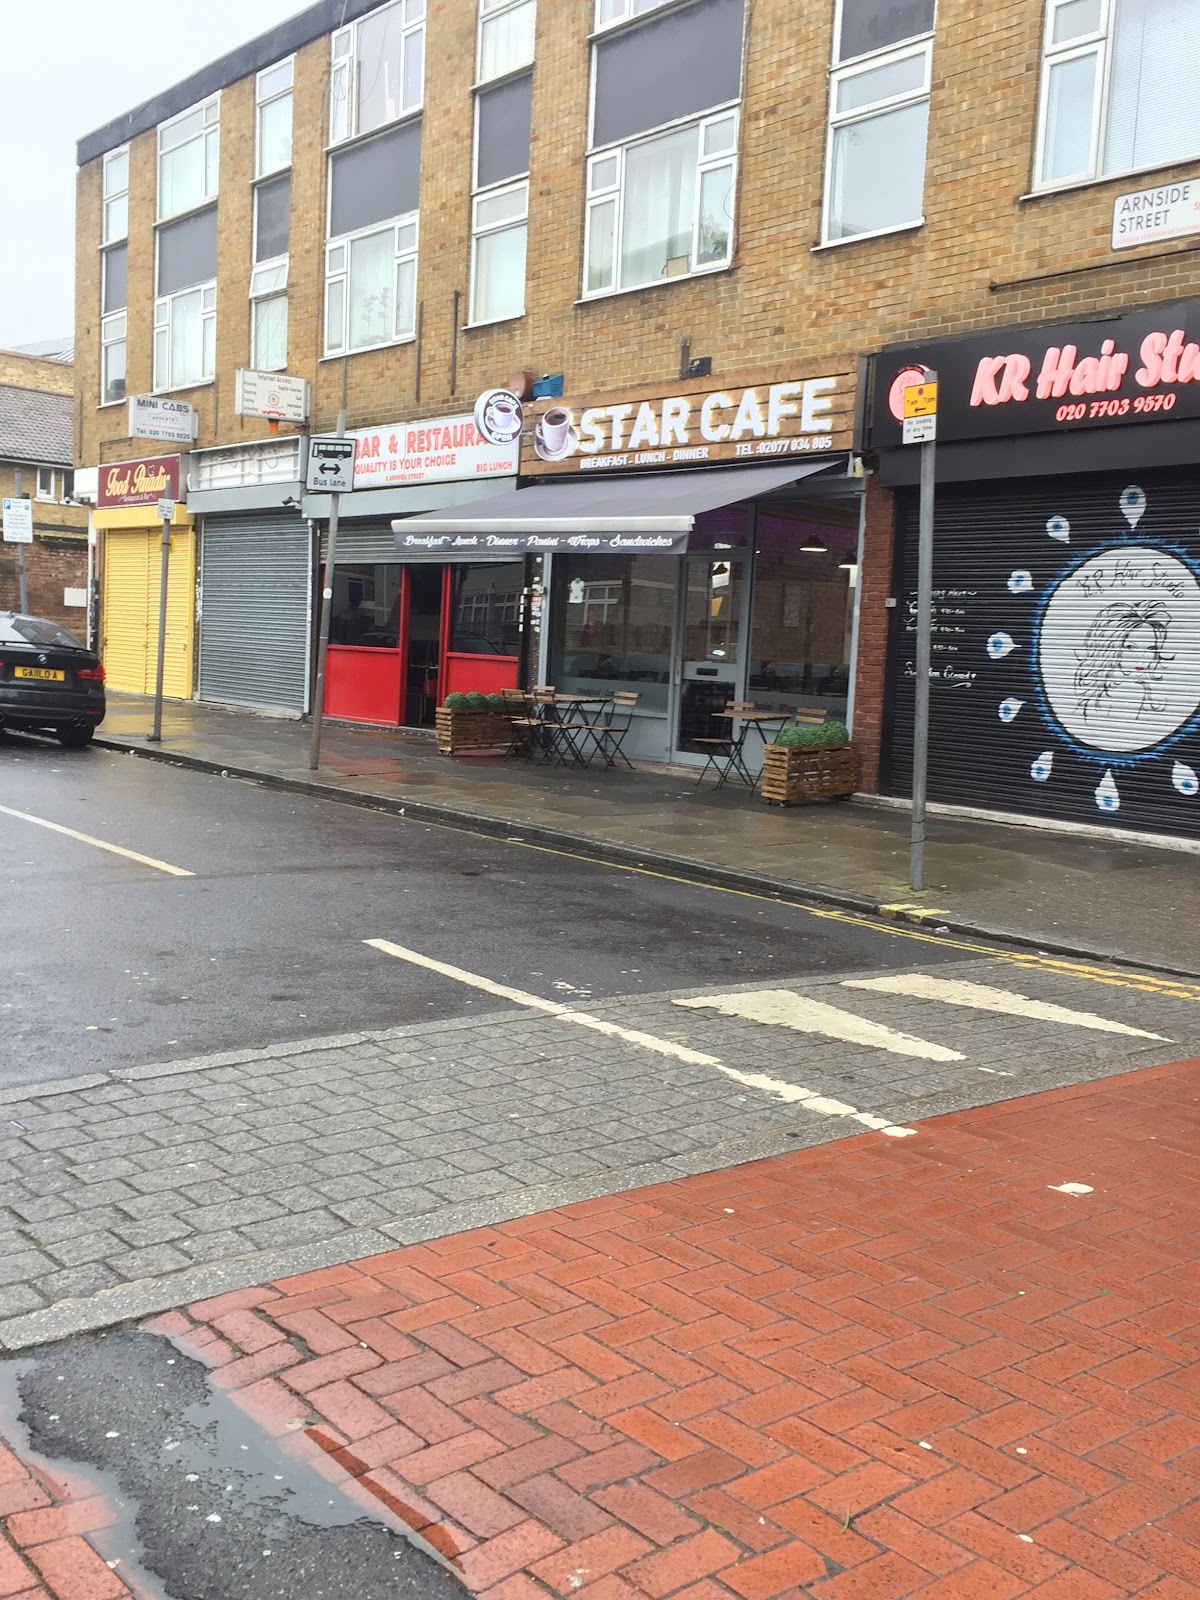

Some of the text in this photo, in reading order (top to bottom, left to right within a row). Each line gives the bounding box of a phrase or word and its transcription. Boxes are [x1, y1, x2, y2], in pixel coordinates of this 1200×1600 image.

[1120, 185, 1190, 214] ARNSIDE
[1119, 209, 1170, 234] STREET
[1117, 236, 1140, 245] LONDON
[1141, 230, 1167, 241] BOROUGH
[257, 373, 276, 382] Internet
[969, 353, 1031, 407] KR
[1035, 338, 1129, 399] Hair
[136, 399, 189, 413] MINI CABS
[579, 377, 836, 453] STAR CAFE
[1056, 393, 1176, 422] 020 7703 9570
[388, 433, 398, 454] &
[406, 422, 489, 454] RESTAURA
[491, 431, 513, 442] OPEN
[735, 444, 754, 456] TEL
[790, 438, 810, 451] 034
[811, 436, 833, 449] 805
[354, 454, 457, 475] QUALITY IS YOUR CHOICE
[476, 460, 513, 473] BIG LUNCH
[580, 455, 629, 469] BREAKFAST
[634, 451, 665, 465] LUNCH
[672, 447, 709, 461] DINNER
[105, 467, 131, 497] Food
[313, 477, 346, 488] Bus lane
[408, 472, 425, 480] STREET
[403, 535, 450, 548] Breakfast
[451, 536, 479, 546] Lunch
[486, 535, 519, 546] Dinner
[526, 535, 560, 546] Panini
[566, 535, 600, 549] Wraps
[609, 534, 673, 548] Sandwiches
[1109, 560, 1143, 588] Hair
